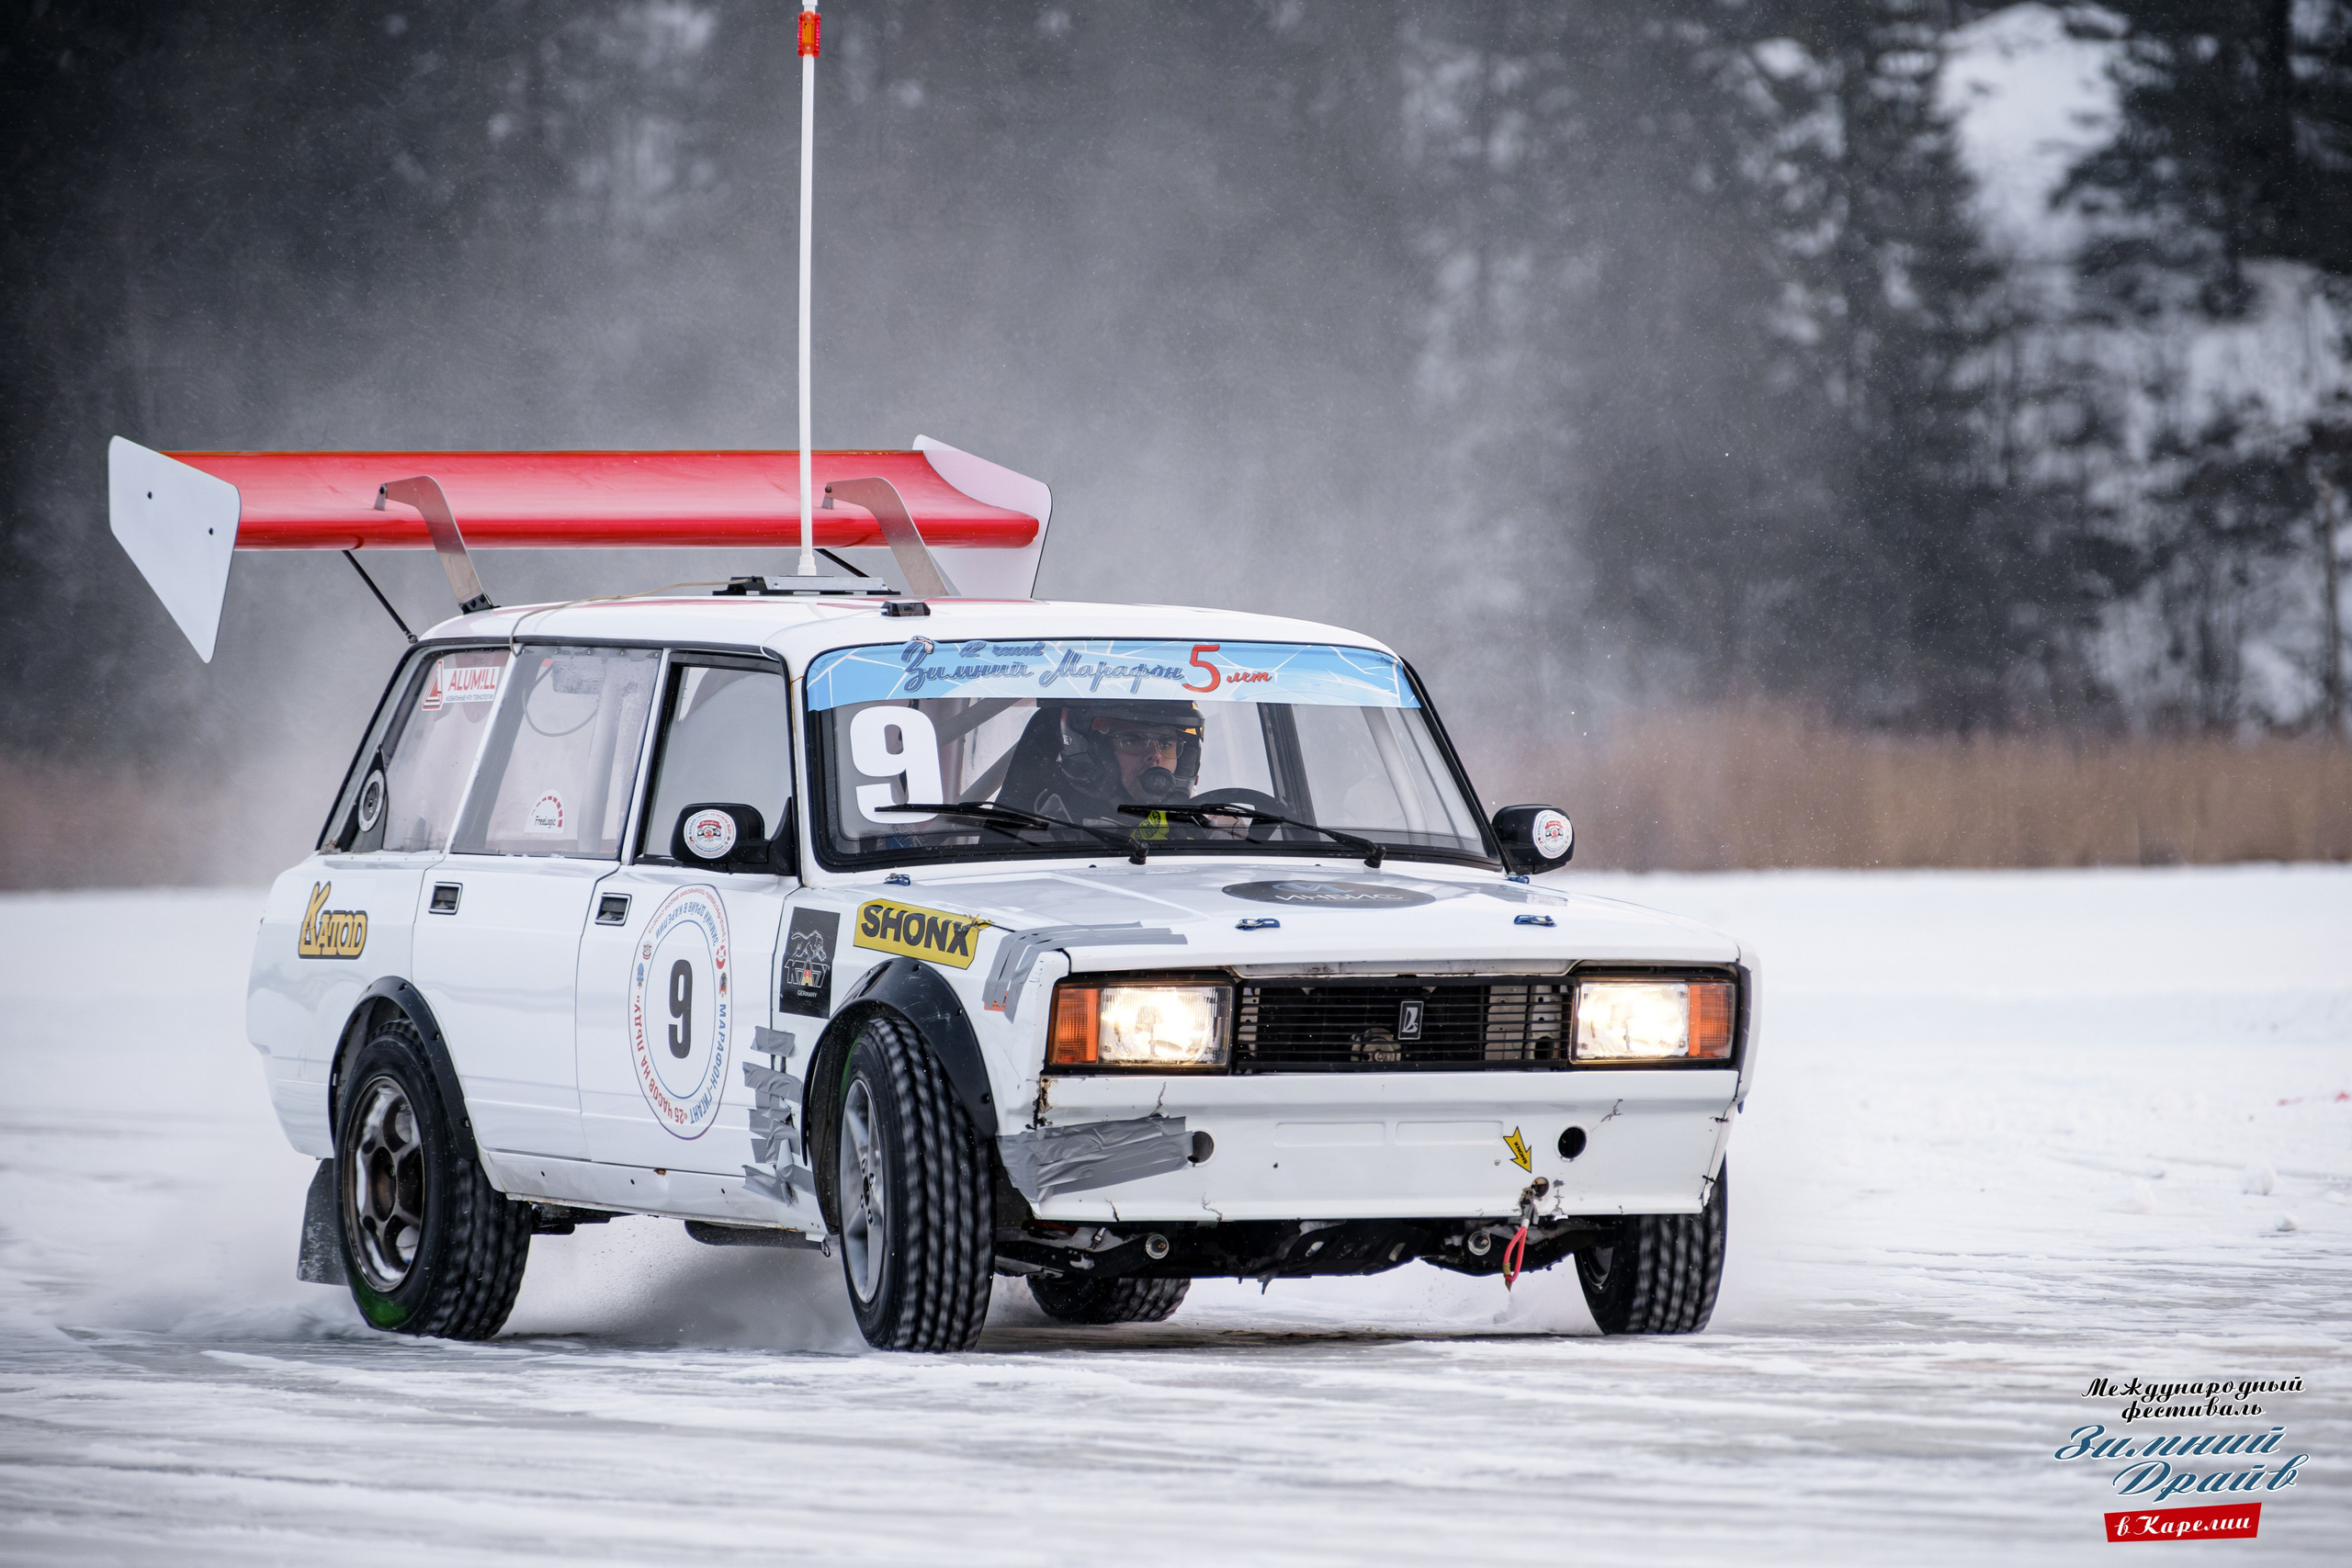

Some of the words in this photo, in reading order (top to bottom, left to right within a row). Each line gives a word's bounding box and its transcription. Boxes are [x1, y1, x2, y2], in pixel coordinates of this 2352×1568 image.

[899, 636, 1034, 694] Зимний
[1038, 648, 1185, 694] Марафон
[959, 641, 987, 658] 12
[990, 641, 1046, 657] часов
[1182, 644, 1220, 694] 5
[1226, 670, 1272, 683] лет
[850, 705, 944, 824] 9
[655, 904, 684, 939] КАРЕЛИИ
[683, 902, 688, 914] В
[861, 904, 971, 957] SHONX
[668, 959, 693, 1059] 9
[797, 989, 818, 998] GERMANY
[640, 1054, 651, 1080] НА
[690, 1003, 727, 1124] МАРАФОН-ГИГАНТ
[648, 1077, 673, 1120] ЧАСОВ
